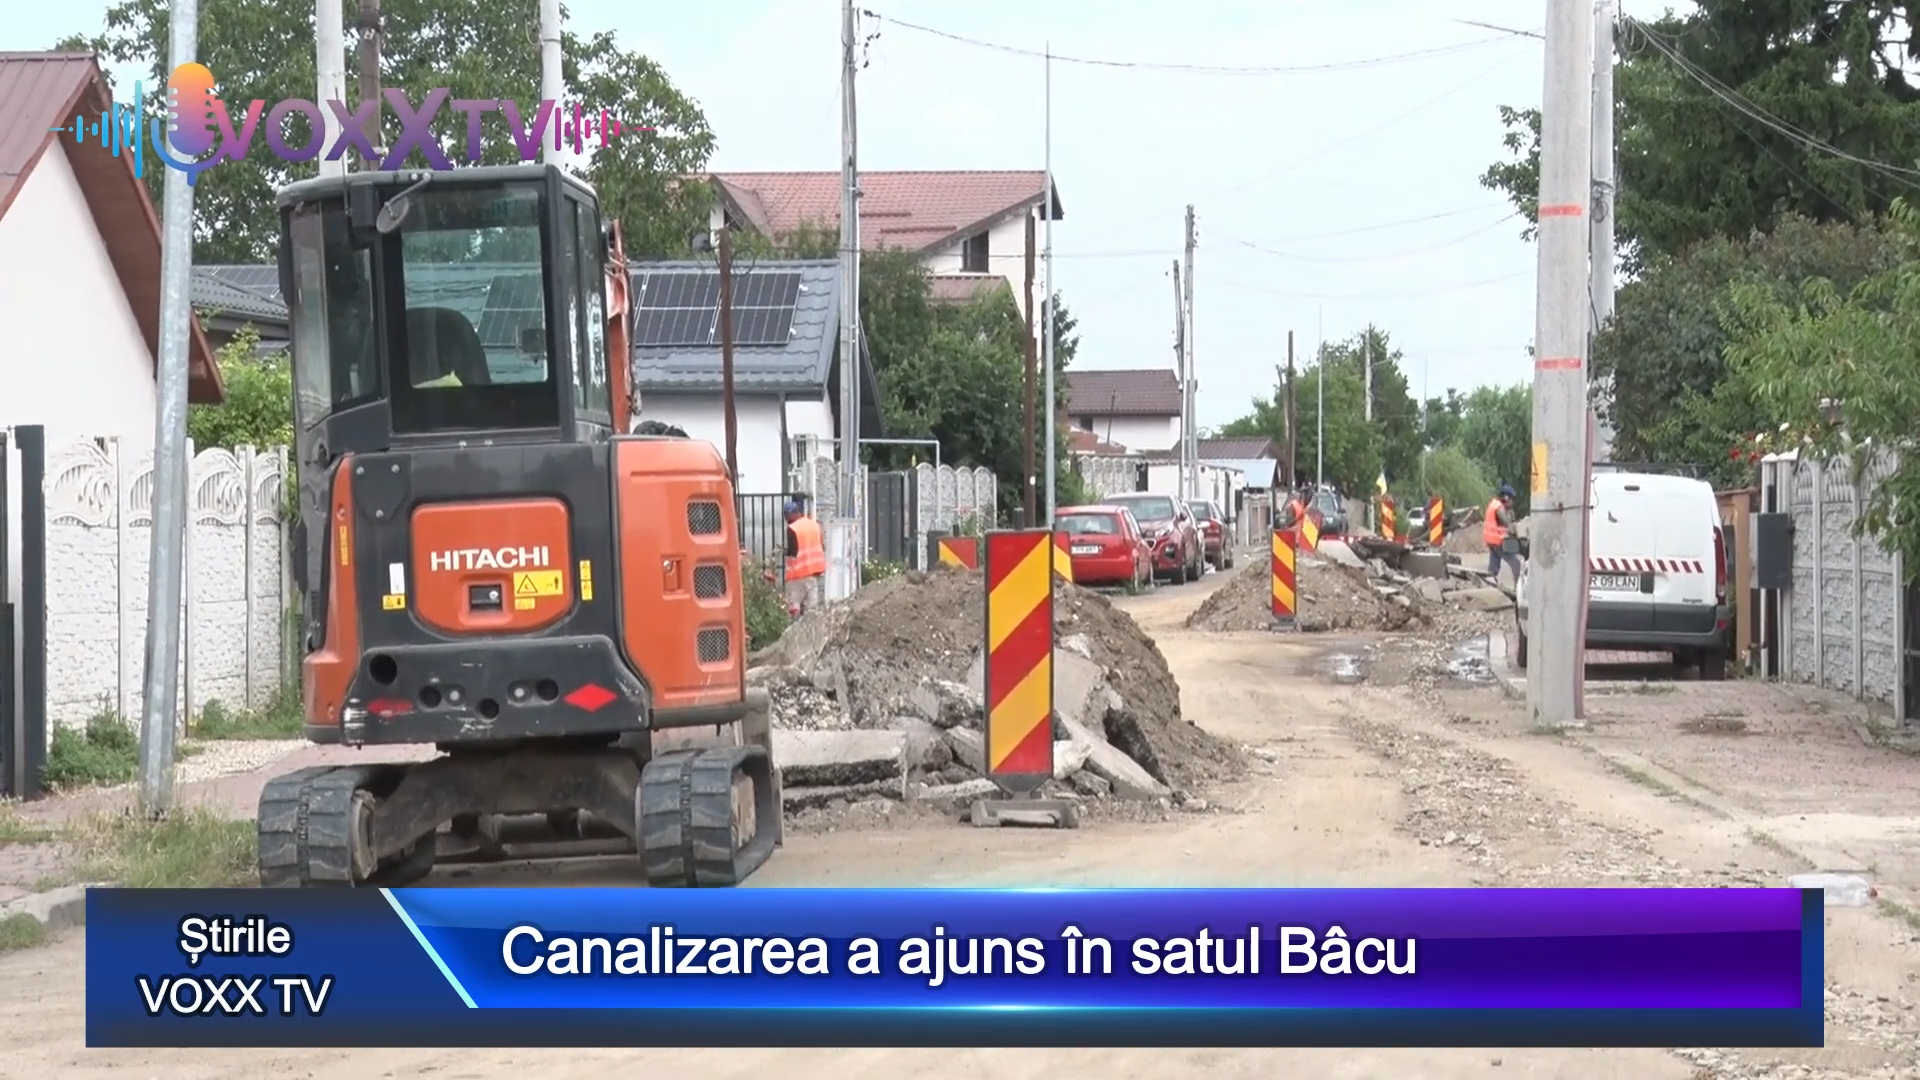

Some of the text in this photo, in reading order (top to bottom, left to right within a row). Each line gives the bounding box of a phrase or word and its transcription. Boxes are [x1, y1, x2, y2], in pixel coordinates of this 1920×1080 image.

[430, 546, 549, 571] HITACHI
[1601, 576, 1613, 586] 09
[1615, 576, 1636, 587] LAN
